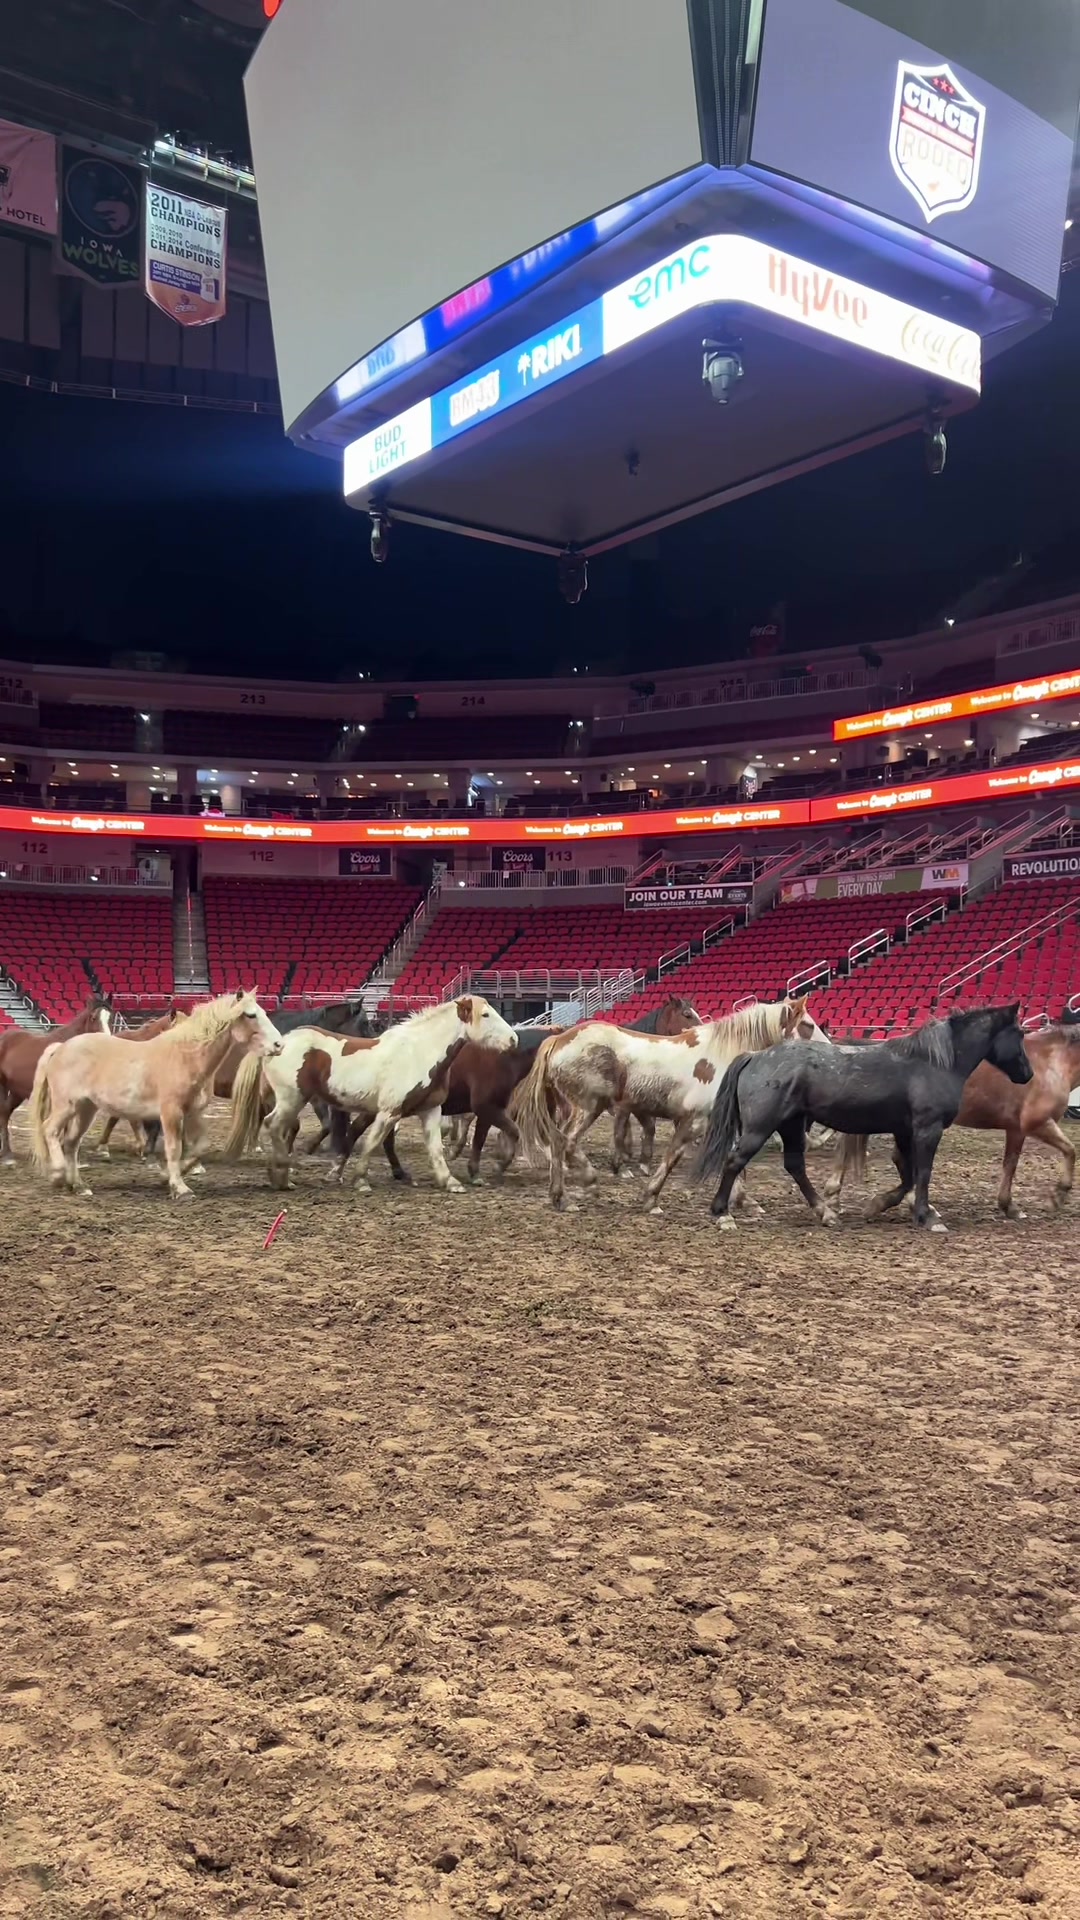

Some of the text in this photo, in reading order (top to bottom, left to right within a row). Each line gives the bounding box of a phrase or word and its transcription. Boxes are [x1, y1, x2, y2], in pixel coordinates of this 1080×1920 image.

[903, 82, 977, 139] CINCH
[902, 129, 969, 185] RODEO
[151, 193, 183, 215] 2011
[7, 207, 46, 226] HOTEL
[151, 207, 221, 238] CHAMPIONS
[81, 236, 123, 257] IOWA
[63, 242, 139, 277] WOLVES
[150, 239, 221, 269] CHAMPIONS
[628, 245, 711, 309] emc
[374, 424, 401, 452] BUD
[369, 440, 406, 474] LIGHT
[240, 694, 266, 704] 213
[461, 696, 486, 706] 214
[914, 702, 952, 719] CENTER
[898, 788, 932, 802] CENTER
[743, 809, 781, 820] CENTER
[105, 820, 145, 830] CENTER
[275, 827, 312, 837] CENTER
[434, 827, 470, 836] CENTER
[590, 821, 623, 832] CENTER
[21, 842, 48, 854] 112
[249, 850, 275, 862] 112
[350, 851, 380, 863] Coors
[502, 850, 534, 862] Coors
[547, 851, 572, 861] 113
[1011, 857, 1080, 876] REVOLUTIO
[932, 868, 960, 880] WM
[629, 888, 723, 902] JOIN OUR TEAM
[837, 881, 883, 897] EVERY DAY
